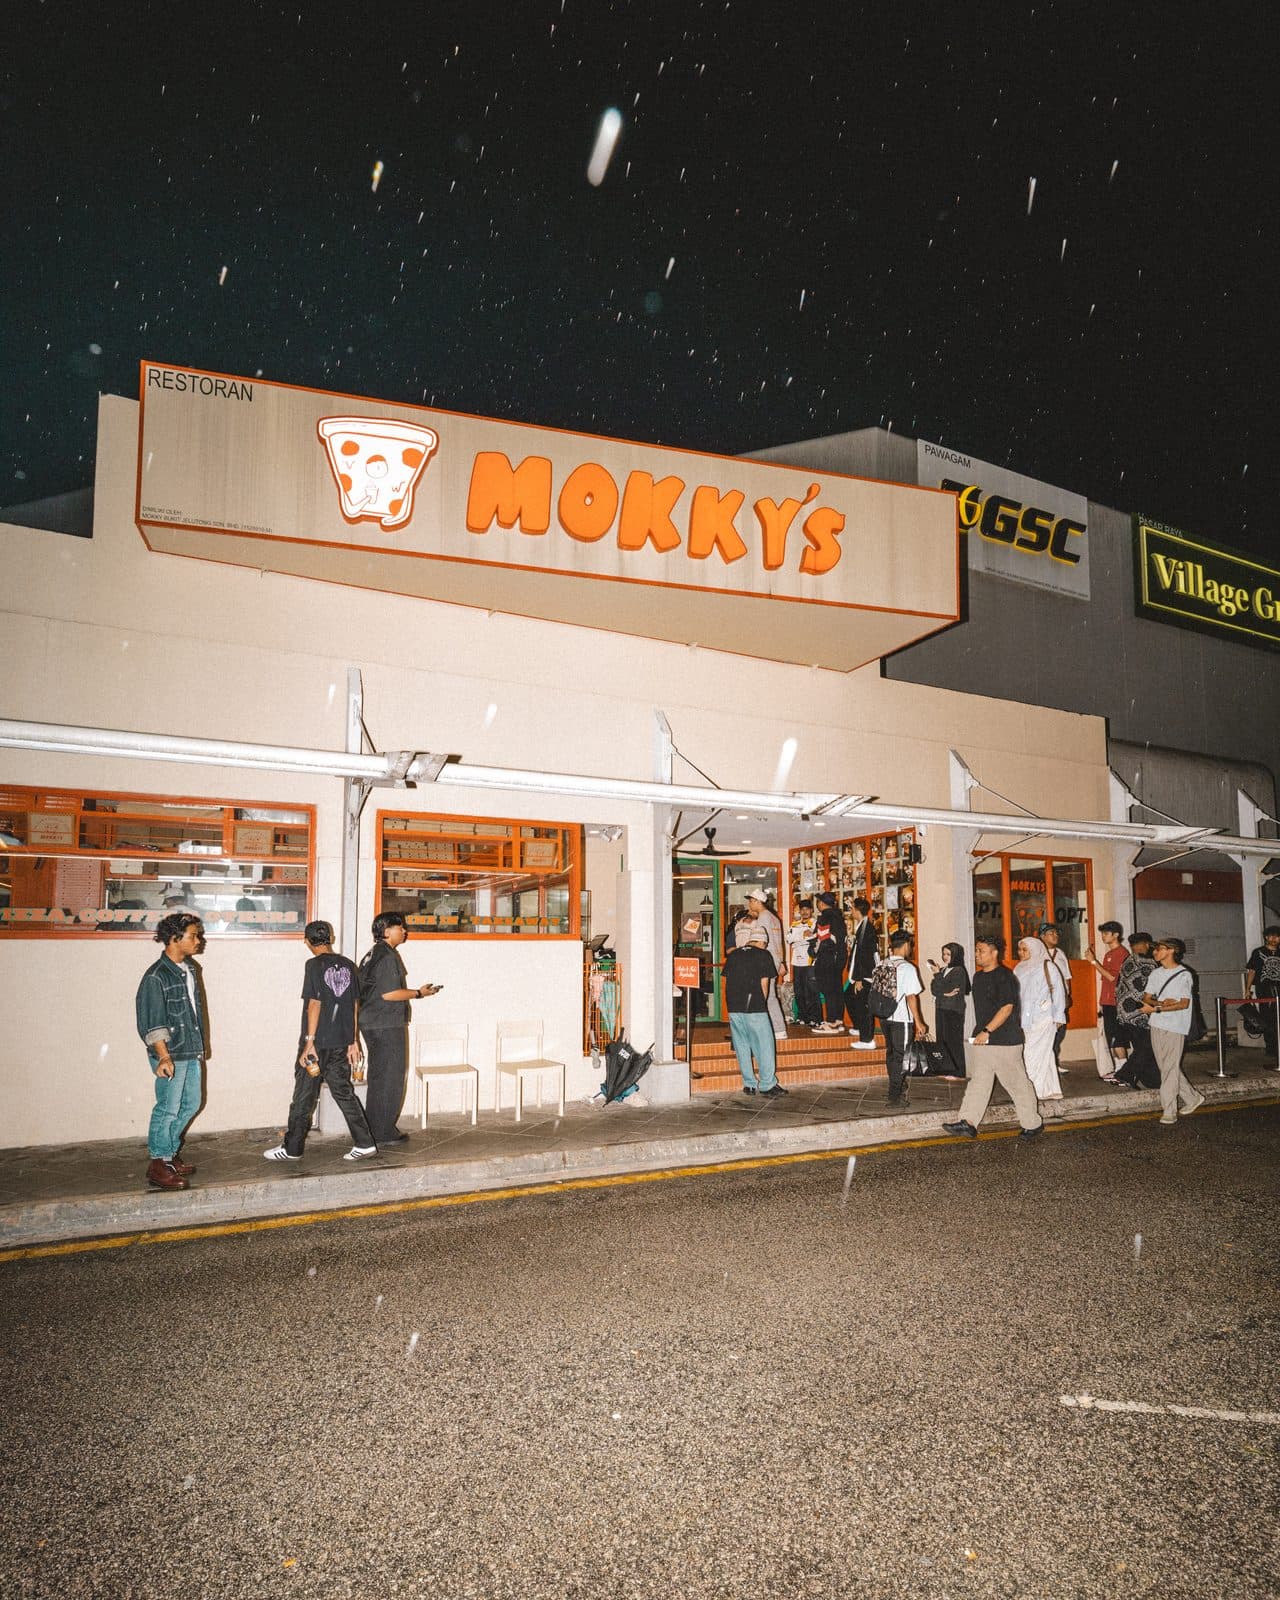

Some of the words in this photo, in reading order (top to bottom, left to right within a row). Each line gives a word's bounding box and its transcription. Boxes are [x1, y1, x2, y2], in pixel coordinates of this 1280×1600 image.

[148, 368, 253, 402] RESTORAN
[924, 444, 971, 469] PAWAGAM
[466, 451, 845, 575] MOKKY'S
[978, 494, 1087, 566] GSC
[1138, 516, 1163, 532] PASAR
[1164, 525, 1183, 538] RAYA
[1150, 552, 1250, 617] Village
[1055, 907, 1089, 924] OPT.
